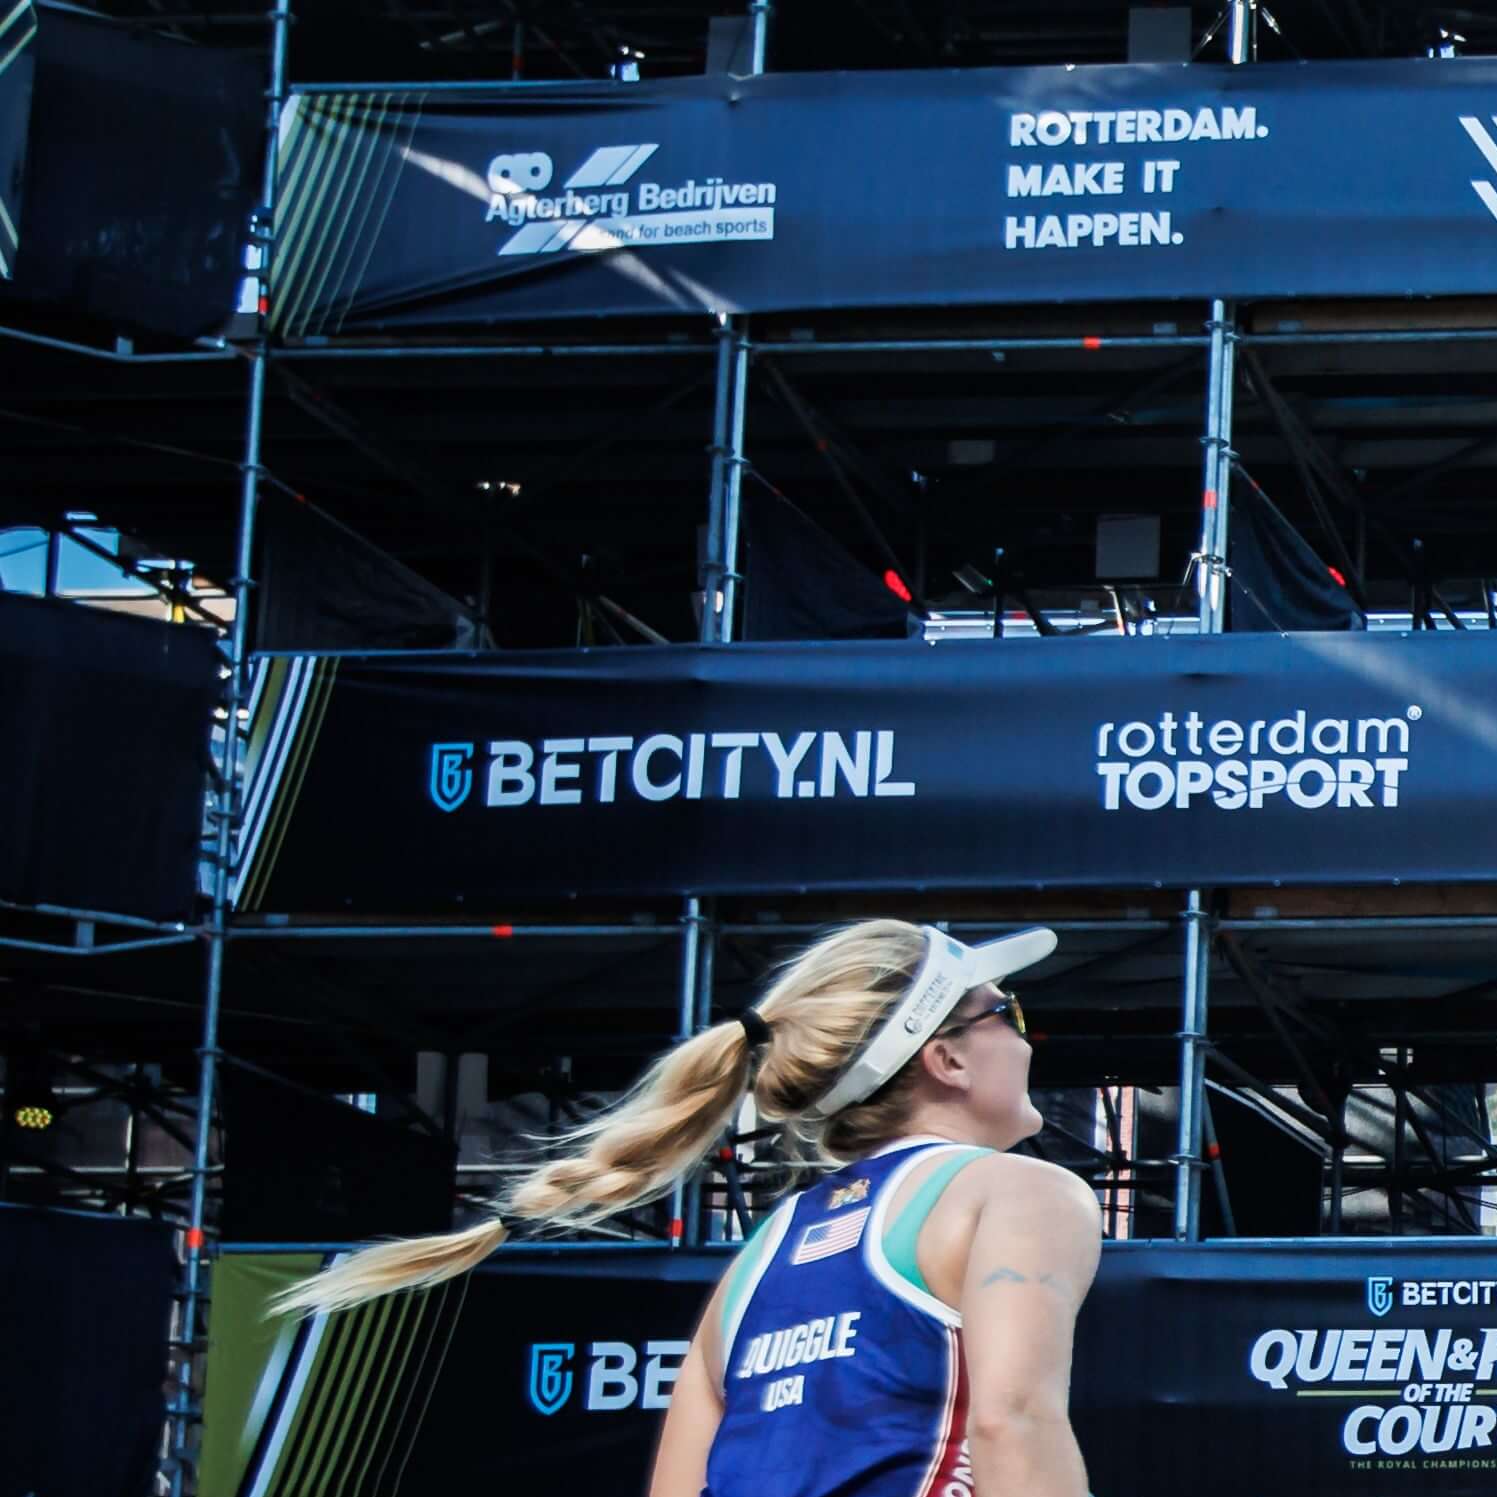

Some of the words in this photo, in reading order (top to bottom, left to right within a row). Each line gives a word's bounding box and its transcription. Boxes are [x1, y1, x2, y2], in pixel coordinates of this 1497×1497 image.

[1009, 107, 1269, 147] ROTTERDAM.
[1007, 162, 1125, 198] MAKE
[1143, 161, 1180, 193] IT
[485, 190, 629, 226] Agterberg
[638, 178, 776, 212] Bedrijven
[640, 223, 659, 239] for
[664, 221, 711, 237] beach
[716, 218, 768, 235] sports
[1005, 211, 1183, 249] HAPPEN.
[487, 730, 915, 807] BETCITY.NL
[1097, 758, 1408, 810] TOPSPORT
[762, 1375, 805, 1412] USA
[1403, 1384, 1433, 1402] OF
[1433, 1383, 1474, 1402] THE
[1350, 1460, 1374, 1469] THE
[1378, 1460, 1416, 1469] ROYAL
